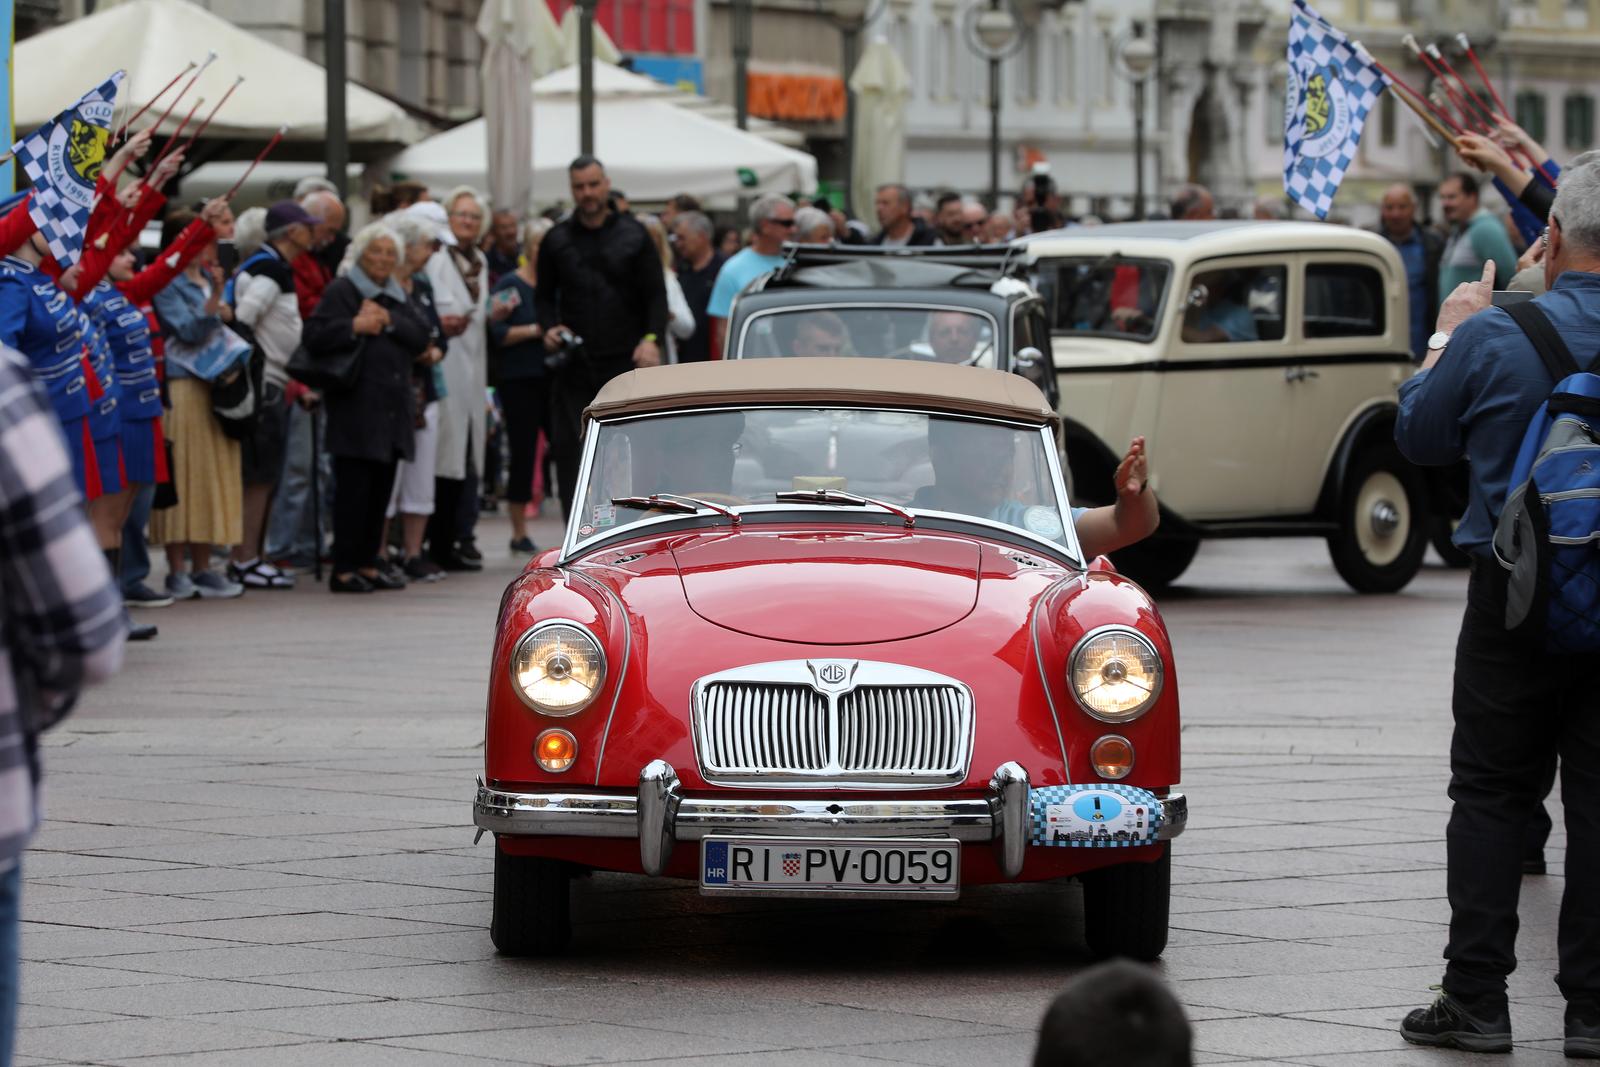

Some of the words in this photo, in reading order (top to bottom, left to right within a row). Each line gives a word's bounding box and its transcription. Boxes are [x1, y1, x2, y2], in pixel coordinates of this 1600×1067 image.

[84, 106, 112, 118] OLD
[52, 144, 65, 182] RIJEKA
[822, 665, 844, 680] MG
[707, 867, 725, 879] HR
[731, 847, 770, 882] RI
